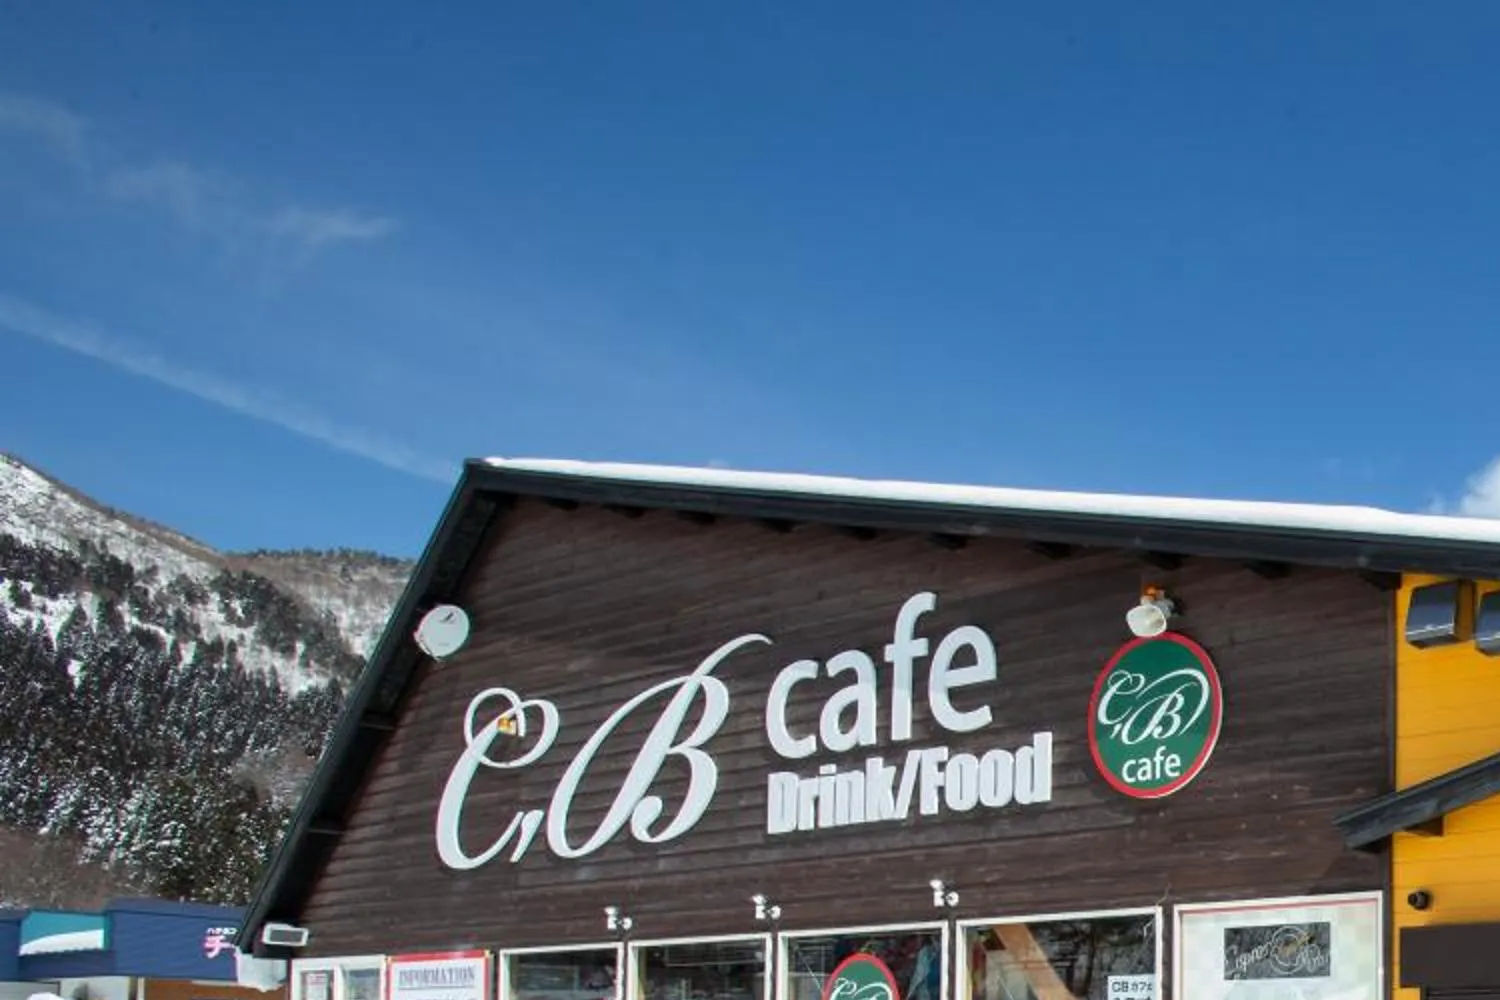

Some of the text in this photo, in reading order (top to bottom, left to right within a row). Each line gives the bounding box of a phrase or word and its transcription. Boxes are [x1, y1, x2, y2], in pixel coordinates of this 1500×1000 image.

[766, 591, 997, 759] cafe
[767, 731, 1053, 834] Drink/Food
[1122, 745, 1181, 783] cafe
[399, 966, 475, 986] INFORMATION
